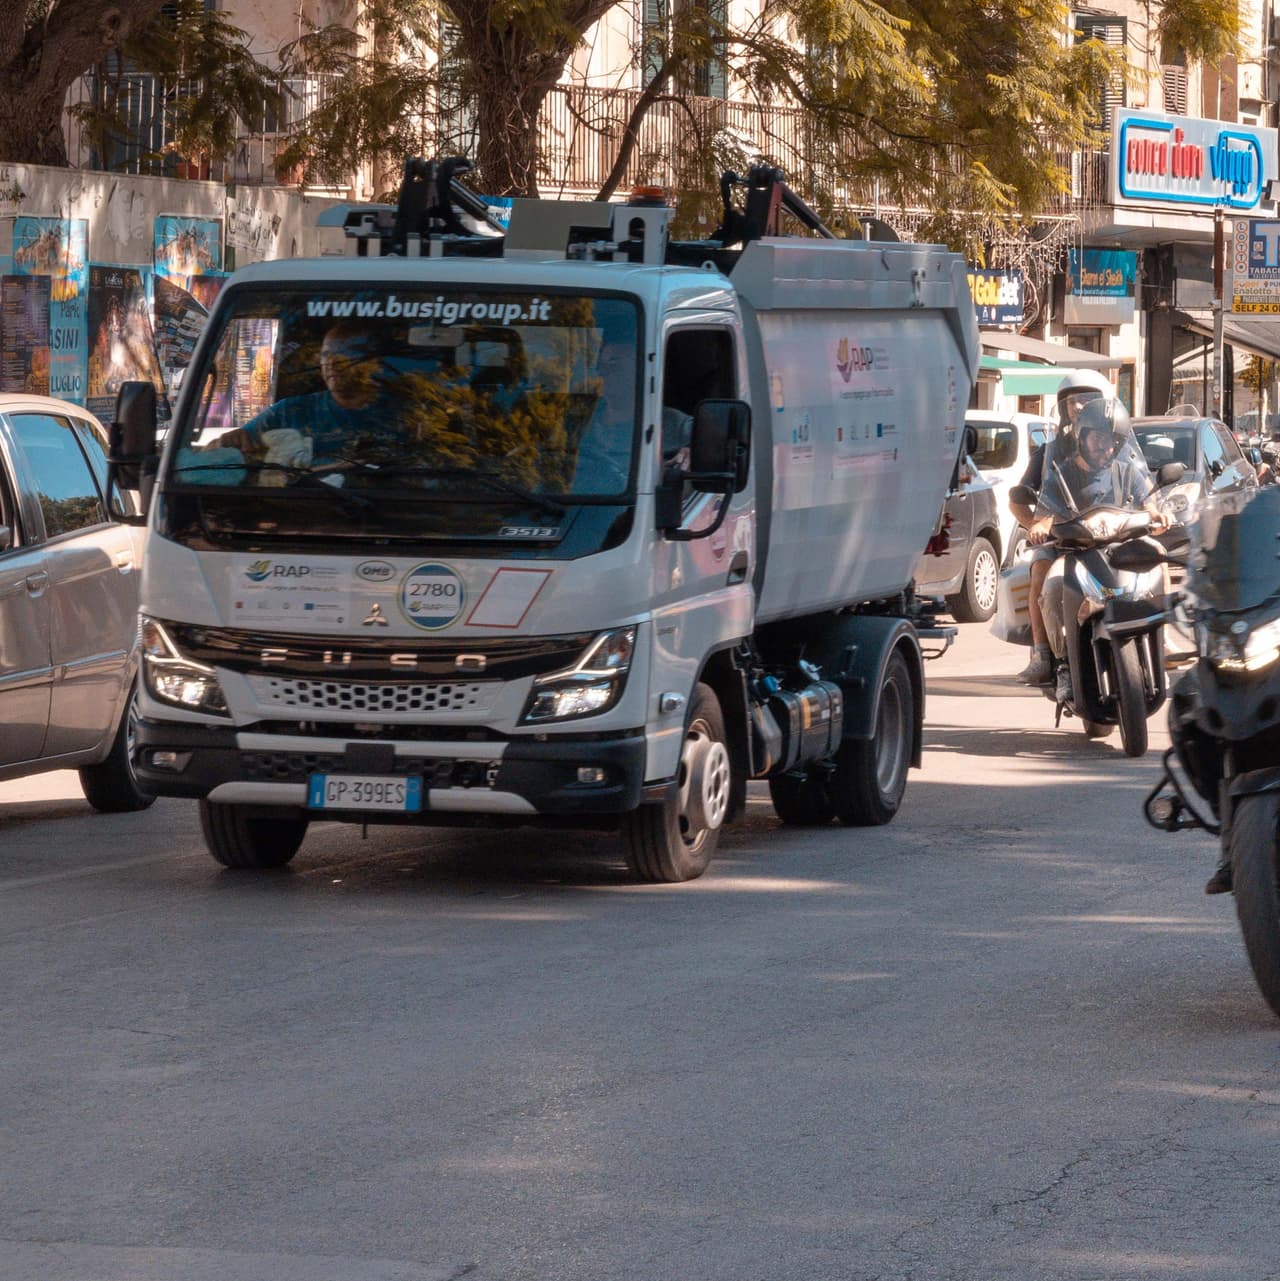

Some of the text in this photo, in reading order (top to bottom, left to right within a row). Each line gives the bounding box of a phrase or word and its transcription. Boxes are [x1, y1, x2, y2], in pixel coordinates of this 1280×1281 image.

[1233, 287, 1272, 295] Enalotto
[307, 296, 551, 324] www.busigroup.it
[1235, 304, 1258, 313] SELF
[1260, 304, 1269, 313] 24
[50, 375, 82, 393] LUGLIO
[273, 565, 310, 576] RAP
[410, 583, 456, 597] 2780
[260, 648, 488, 671] FUSO
